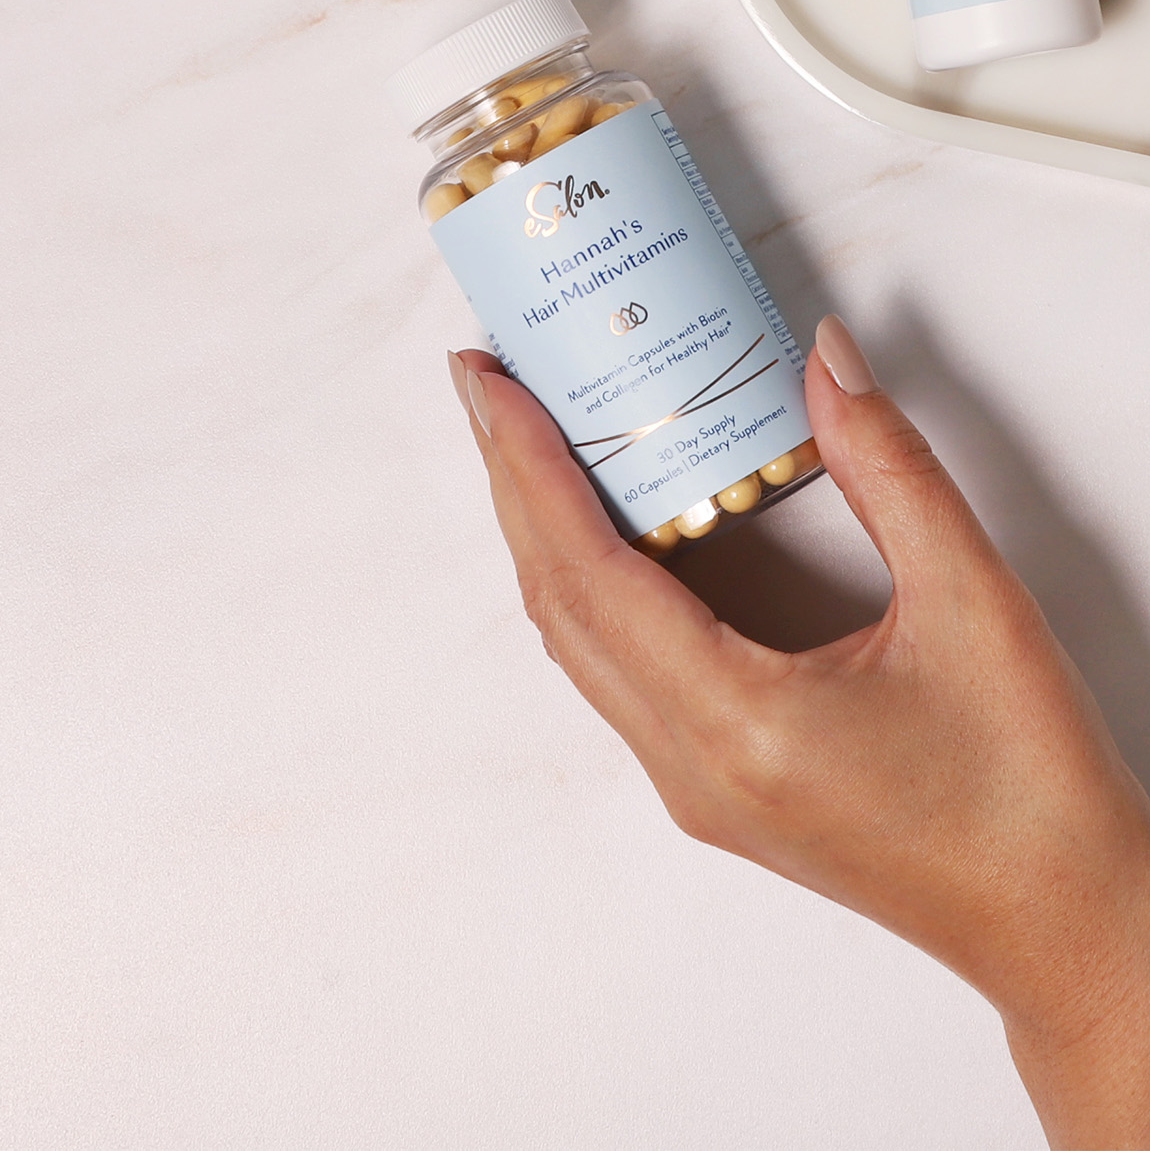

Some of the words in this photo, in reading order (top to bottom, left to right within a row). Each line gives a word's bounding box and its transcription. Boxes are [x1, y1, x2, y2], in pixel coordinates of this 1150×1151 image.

[522, 299, 560, 329] Hair
[560, 227, 688, 306] Multivitamins
[540, 219, 643, 284] Hannah's
[567, 364, 628, 403] Multivitamin
[627, 337, 676, 367] Capsules
[676, 322, 699, 340] with
[698, 306, 728, 328] Biotin
[585, 397, 603, 415] and
[602, 373, 649, 403] Collagen
[648, 362, 665, 377] for
[666, 338, 709, 367] Healthy
[624, 488, 639, 504] 60
[638, 467, 684, 495] Capsules
[688, 439, 731, 467] Dietary
[730, 405, 787, 443] Supplement
[656, 447, 674, 464] 30
[674, 436, 699, 454] Day
[698, 414, 737, 440] Supply
